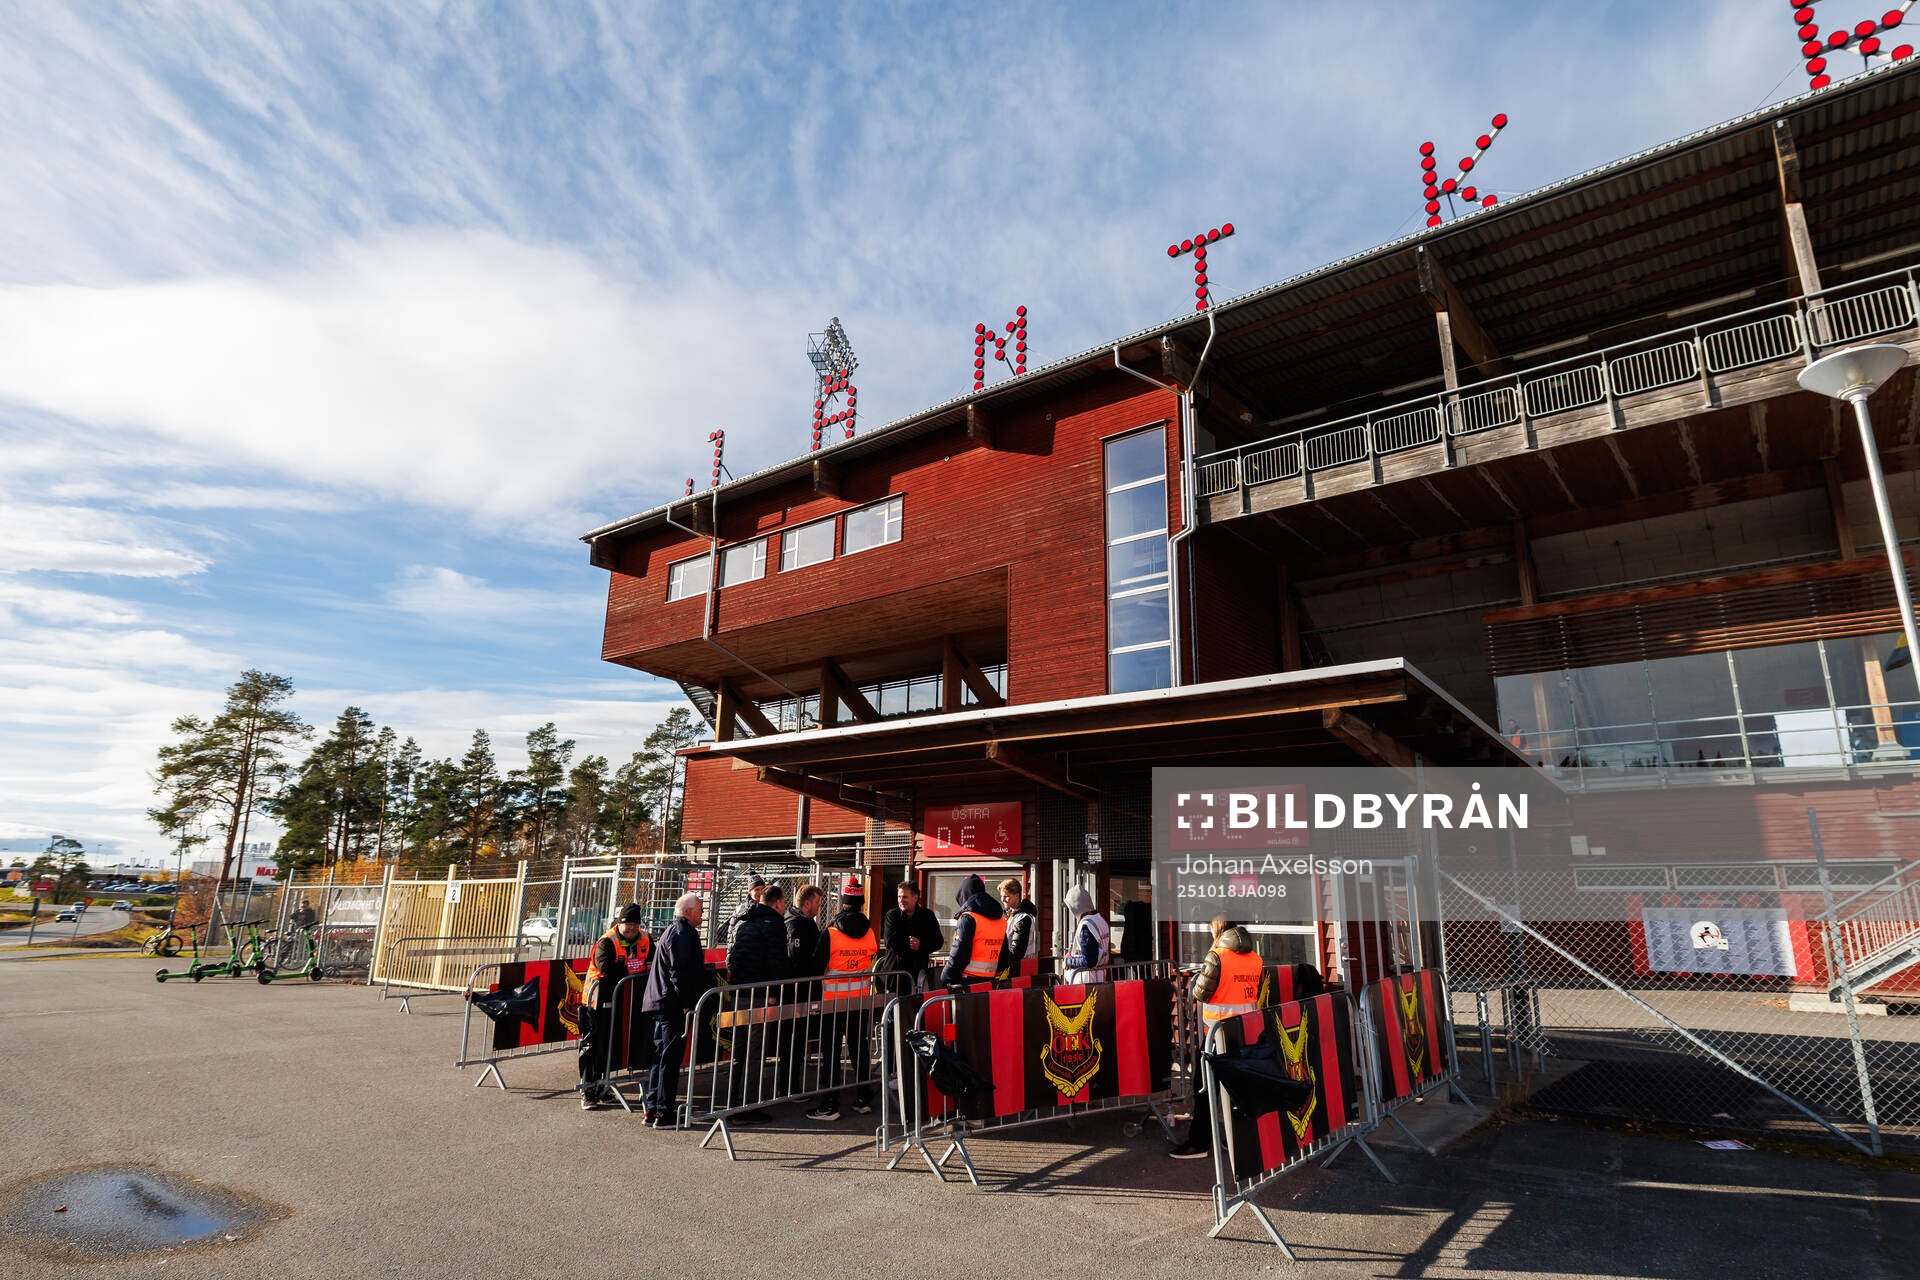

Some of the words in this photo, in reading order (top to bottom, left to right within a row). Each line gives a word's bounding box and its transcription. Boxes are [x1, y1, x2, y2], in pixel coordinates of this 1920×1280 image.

[952, 807, 990, 820] ÖSTRA
[937, 826, 951, 848] D
[961, 825, 975, 848] E
[451, 889, 456, 901] 2
[846, 959, 859, 970] 164
